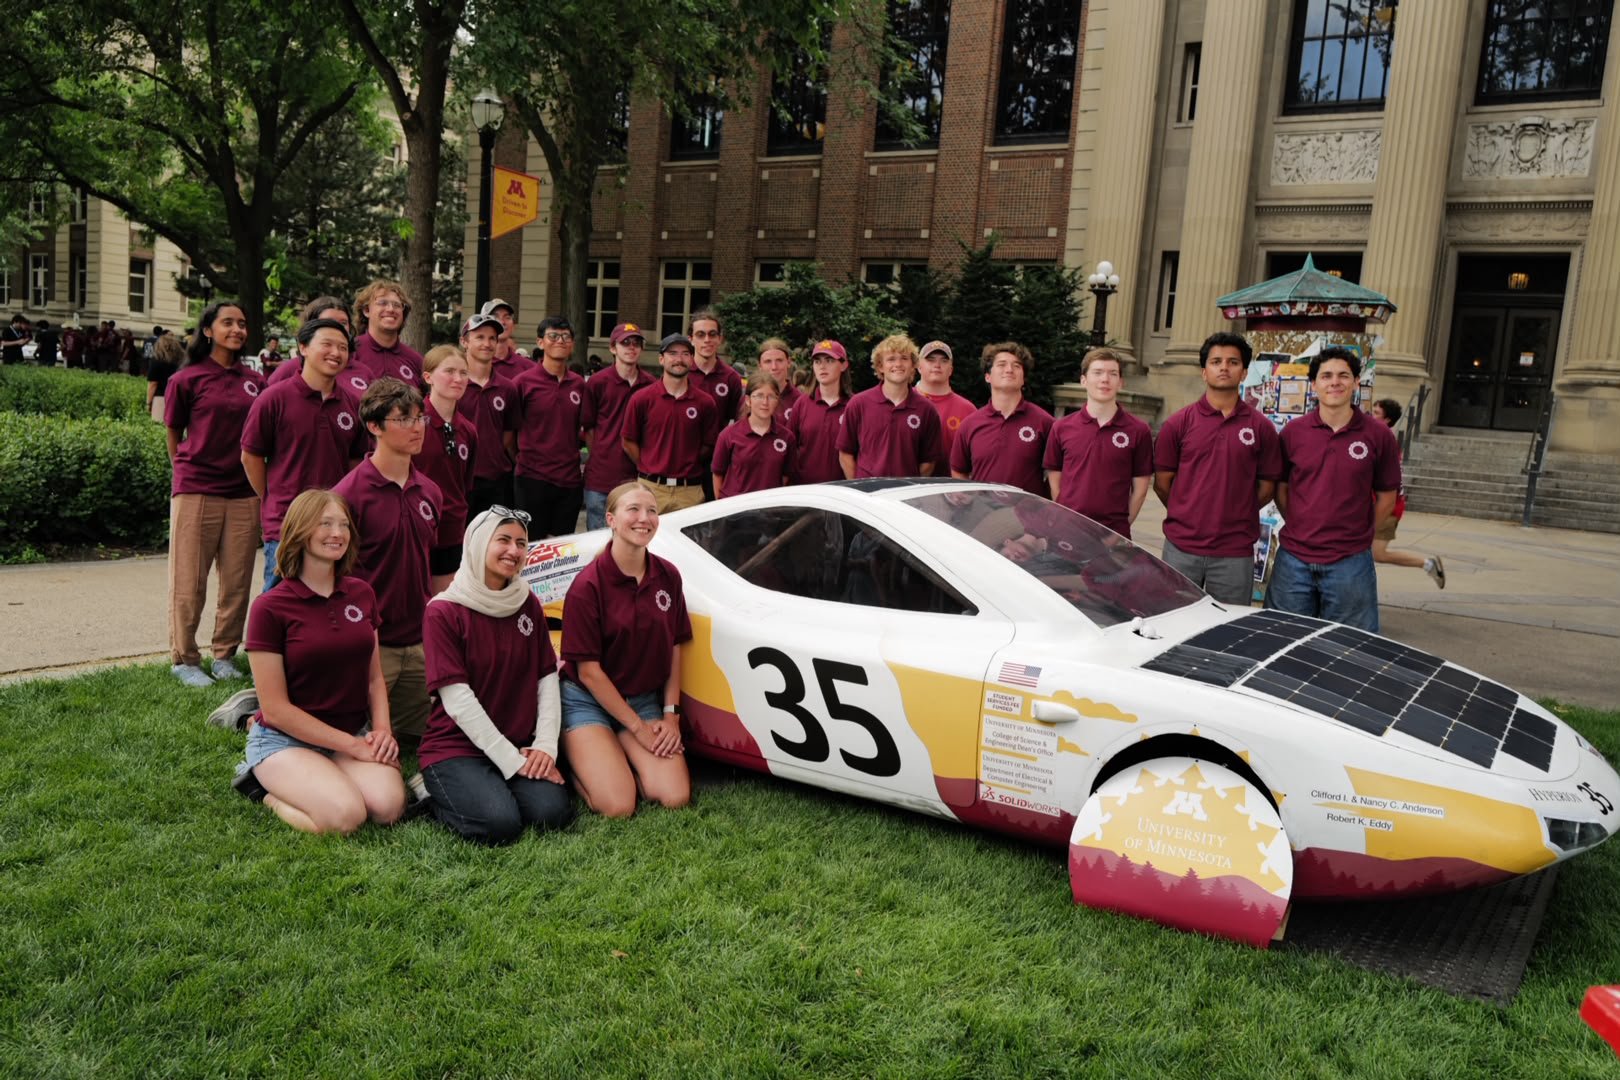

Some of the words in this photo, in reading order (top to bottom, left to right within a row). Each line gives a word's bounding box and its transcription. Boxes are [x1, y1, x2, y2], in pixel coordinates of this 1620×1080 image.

[987, 697, 1010, 707] SERVICES
[993, 693, 1015, 701] STUDENT
[748, 646, 901, 777] 35
[992, 704, 1013, 712] FUNDED
[985, 737, 1016, 750] Engineering
[1017, 743, 1036, 753] Dean's
[1036, 748, 1054, 757] Office
[992, 731, 1012, 740] College
[1020, 737, 1041, 746] Science
[983, 764, 1014, 777] Department
[1022, 773, 1048, 784] Electrical
[986, 773, 1014, 784] Computer
[1014, 779, 1046, 793] Engineering
[998, 794, 1060, 816] SOLIDWORKS
[1162, 790, 1209, 822] M
[1310, 789, 1342, 801] Clifford
[1351, 796, 1358, 804] &
[1360, 796, 1387, 809] Nancy
[1390, 801, 1400, 810] C.
[1401, 802, 1444, 816] Anderson
[1576, 782, 1614, 816] 35
[1326, 812, 1356, 825] Robert
[1358, 818, 1366, 826] K.
[1369, 820, 1392, 830] Eddy
[1137, 817, 1227, 848] UNIVERSITY
[1124, 837, 1143, 850] OF
[1146, 839, 1233, 869] MINNESOTA
